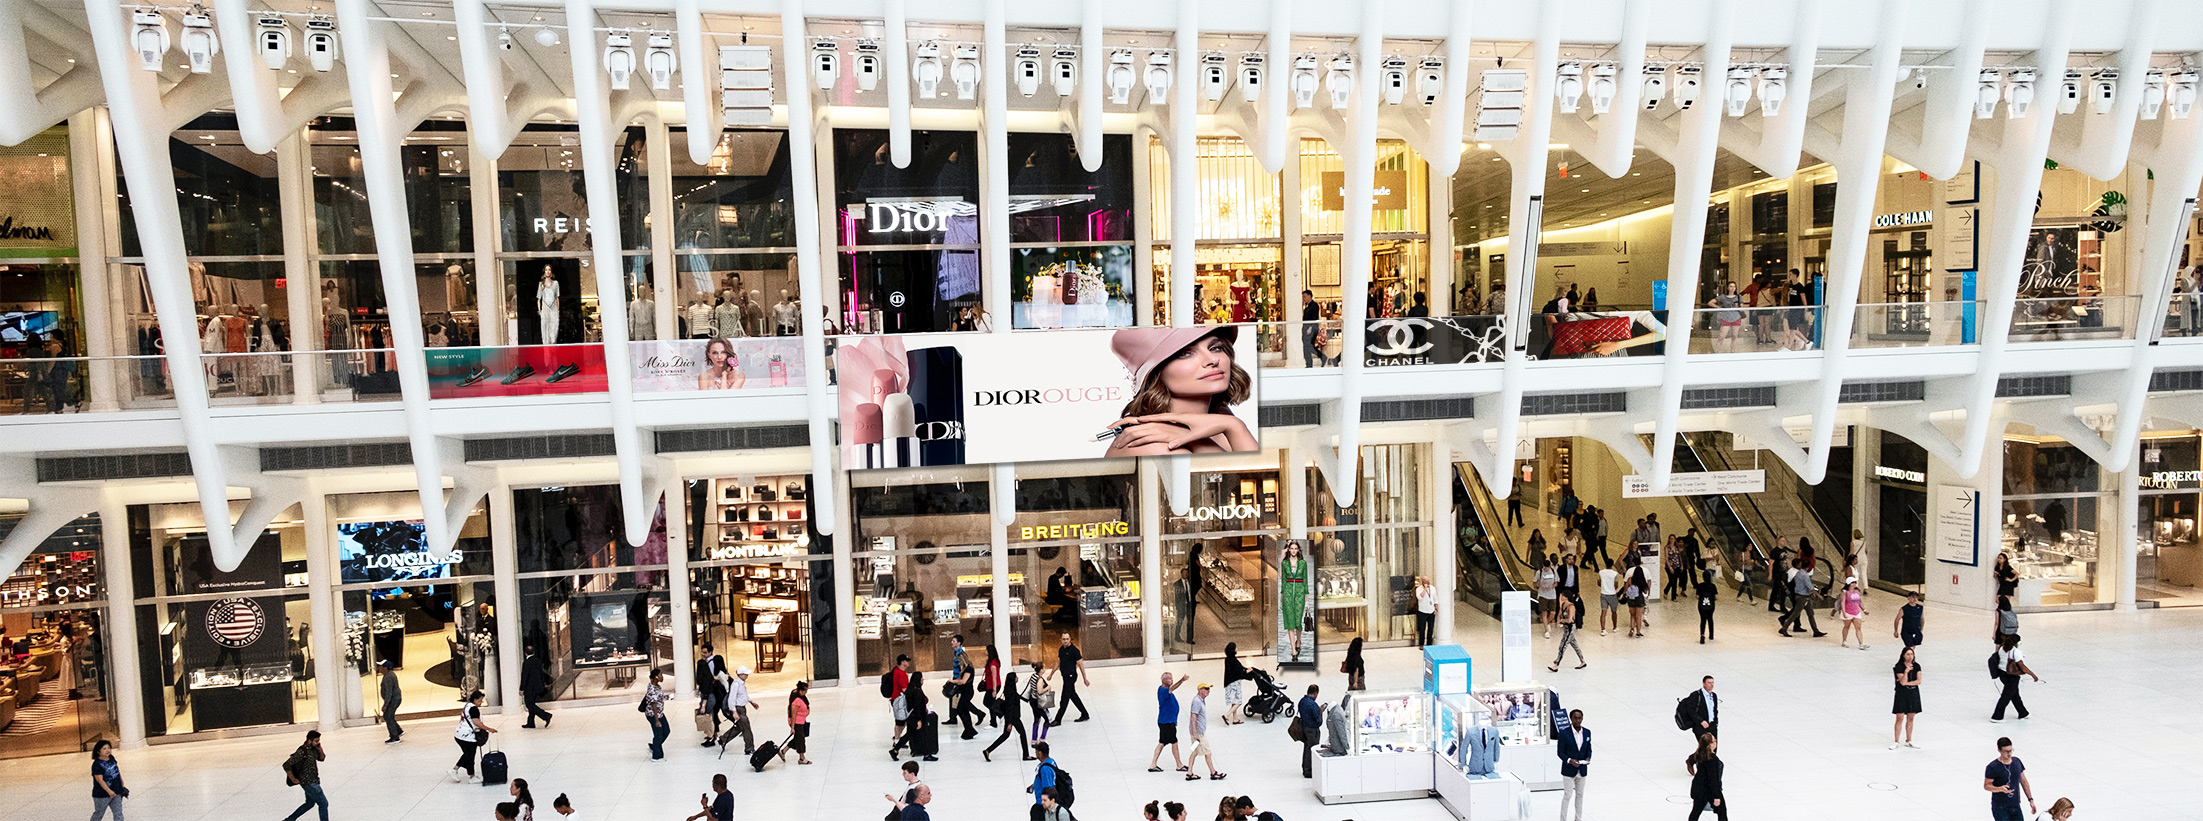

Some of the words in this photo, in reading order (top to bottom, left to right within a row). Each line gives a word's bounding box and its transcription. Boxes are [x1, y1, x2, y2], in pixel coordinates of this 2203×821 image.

[868, 203, 953, 232] Dior
[1875, 213, 1904, 227] COLE
[1904, 209, 1934, 224] HAAN
[638, 355, 669, 369] Miss
[670, 355, 696, 368] Dior
[1365, 356, 1435, 367] CHANEL
[1874, 465, 1906, 480] ROBERTO
[1905, 470, 1926, 483] COIN
[1188, 503, 1262, 522] LONDON
[1020, 521, 1129, 540] BREITLING
[711, 542, 799, 560] MONTBLANC
[223, 597, 245, 605] USA
[208, 608, 225, 643] EDITION
[234, 605, 263, 646] EXCLUSIVE
